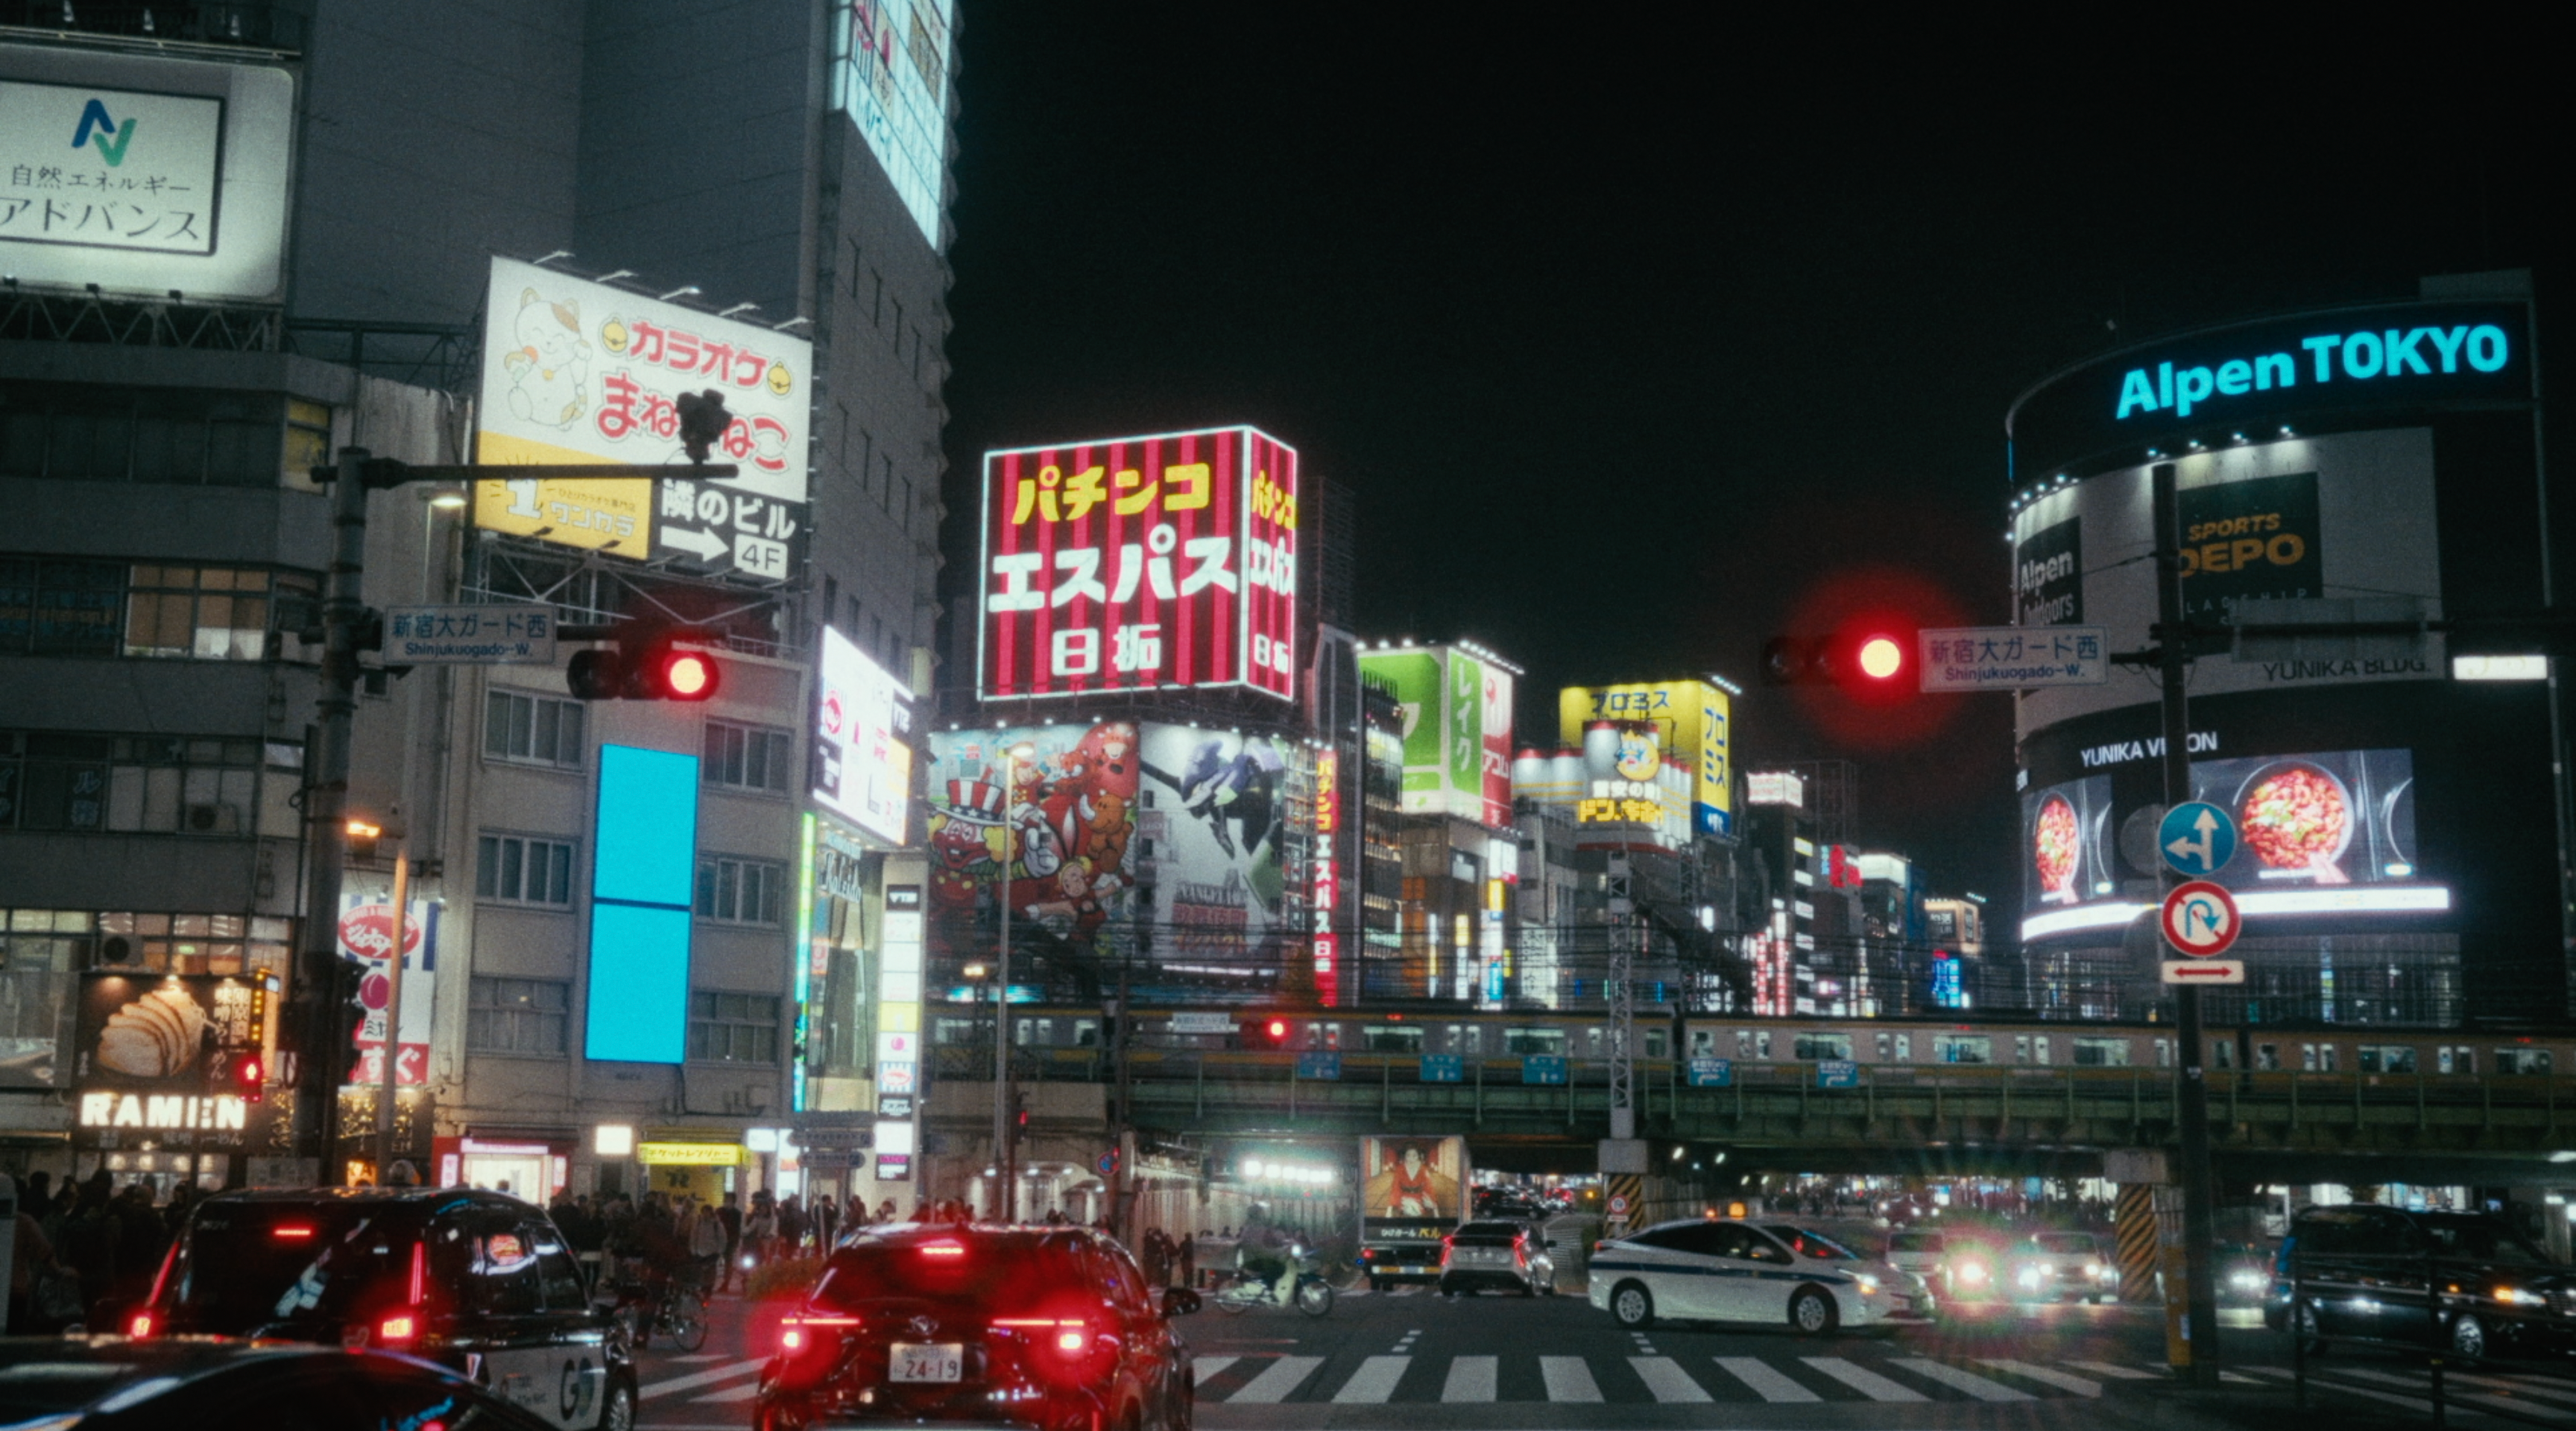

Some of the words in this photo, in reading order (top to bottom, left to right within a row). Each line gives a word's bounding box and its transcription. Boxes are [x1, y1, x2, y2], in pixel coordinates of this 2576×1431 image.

[12, 164, 192, 195] 自然エネルギー
[0, 198, 200, 240] アドバンス
[631, 320, 768, 386] カラオケ
[2116, 352, 2295, 419] Alpen
[2302, 325, 2508, 384] TOKYO
[598, 373, 789, 470] まねねこ
[662, 478, 795, 540] 隣のビル
[1011, 463, 1210, 524] パチンコ
[1251, 470, 1297, 530] パチンコ
[549, 501, 637, 537] ワンカラ
[2188, 513, 2281, 542] SPORTS
[742, 543, 782, 572] 4F
[988, 524, 1237, 612] エスパス
[2021, 552, 2074, 597] Alpen
[392, 613, 548, 639] 新宿大ガード西
[405, 641, 533, 658] Shinjukuogado-W.
[1052, 624, 1161, 675] 日拓
[1931, 635, 2099, 663] 新宿大ガード西
[1945, 663, 2086, 682] Shinjukuogado-W.
[2263, 660, 2358, 681] YUNIKA
[1456, 662, 1473, 771] レイク
[1591, 690, 1670, 713] プロミス
[1483, 748, 1509, 780] アコム
[2080, 741, 2144, 768] YUNIKA
[2146, 730, 2218, 757] VION
[362, 1045, 421, 1081] すぐ
[80, 1092, 247, 1129] RAMEN
[905, 1359, 958, 1379] 24-19
